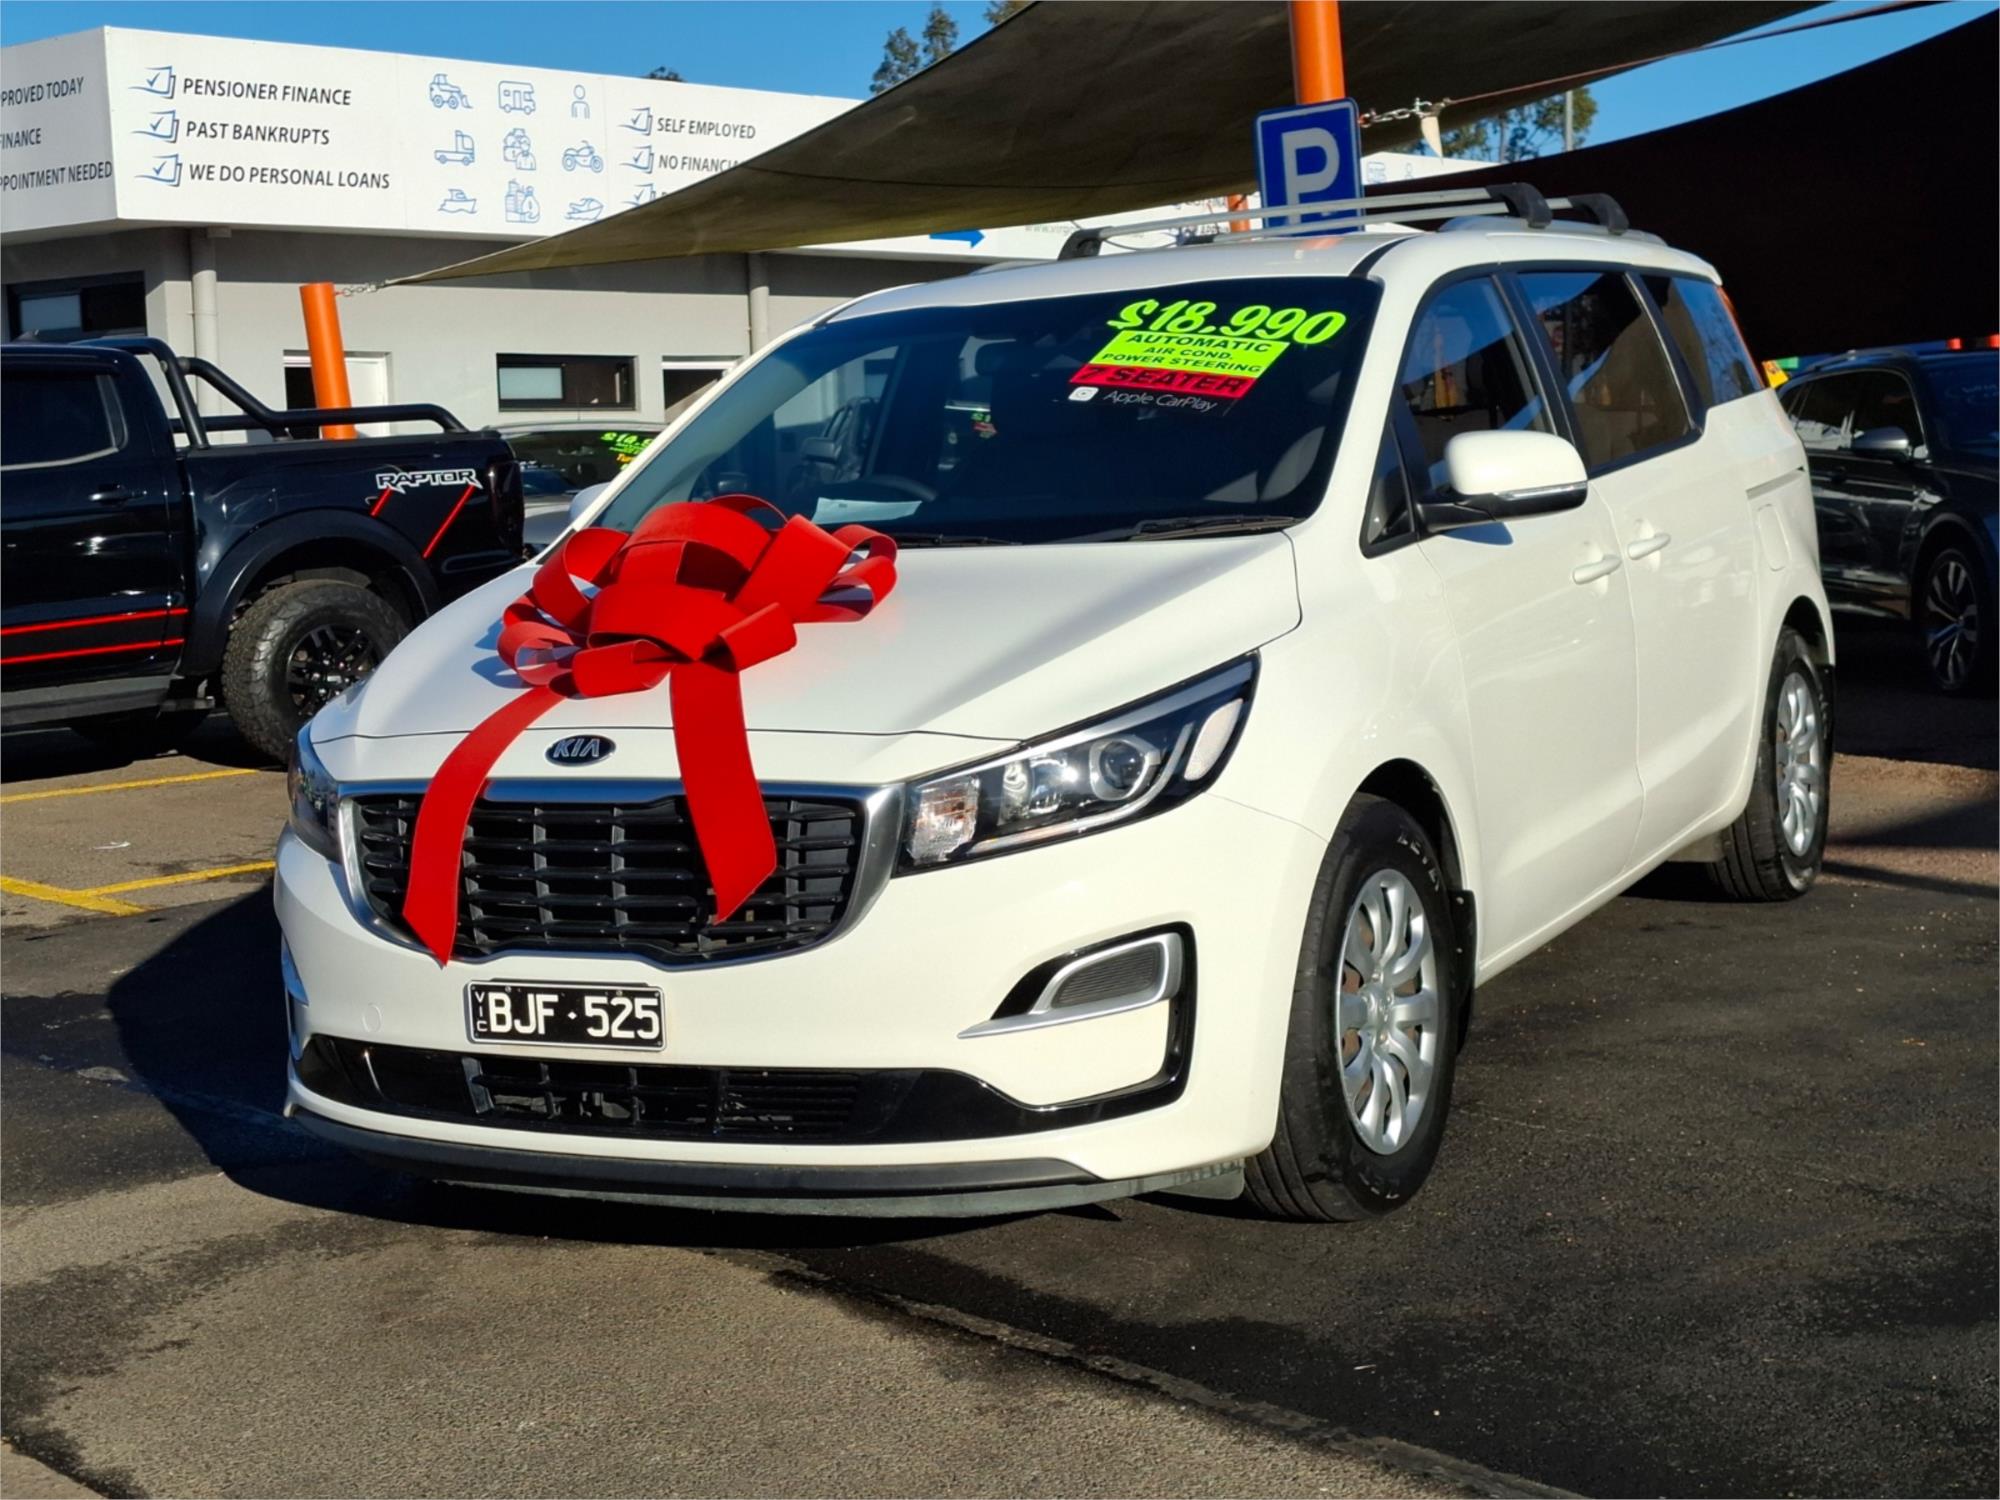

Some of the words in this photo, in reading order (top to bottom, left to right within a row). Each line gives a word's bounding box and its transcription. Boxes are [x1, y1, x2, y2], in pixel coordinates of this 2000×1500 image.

[46, 76, 84, 99] TODAY
[183, 78, 278, 100] PENSIONER
[282, 86, 352, 106] FINANCE
[186, 121, 229, 140] PAST
[232, 124, 330, 145] BANKRUPTS
[657, 117, 686, 134] SELF
[688, 120, 756, 140] EMPLOYED
[68, 161, 113, 183] NEEDED
[659, 154, 679, 170] NO
[189, 163, 216, 181] WE
[219, 165, 245, 183] DO
[249, 167, 333, 187] PERSONAL
[338, 171, 391, 189] LOANS
[1281, 127, 1341, 226] P
[1126, 333, 1273, 353] AUTOMATIC
[1144, 346, 1175, 356] AIR
[1180, 348, 1234, 361] COND.
[1101, 352, 1164, 365] POWER
[1169, 358, 1263, 373] STEERING
[1105, 366, 1250, 394] SEATER
[1103, 390, 1155, 406] Apple
[1155, 393, 1218, 413] CarPlay
[376, 469, 483, 495] RAPTOR
[553, 739, 600, 758] KIA
[475, 991, 489, 1032] VIC
[488, 991, 559, 1035] BJF
[584, 996, 660, 1040] 525
